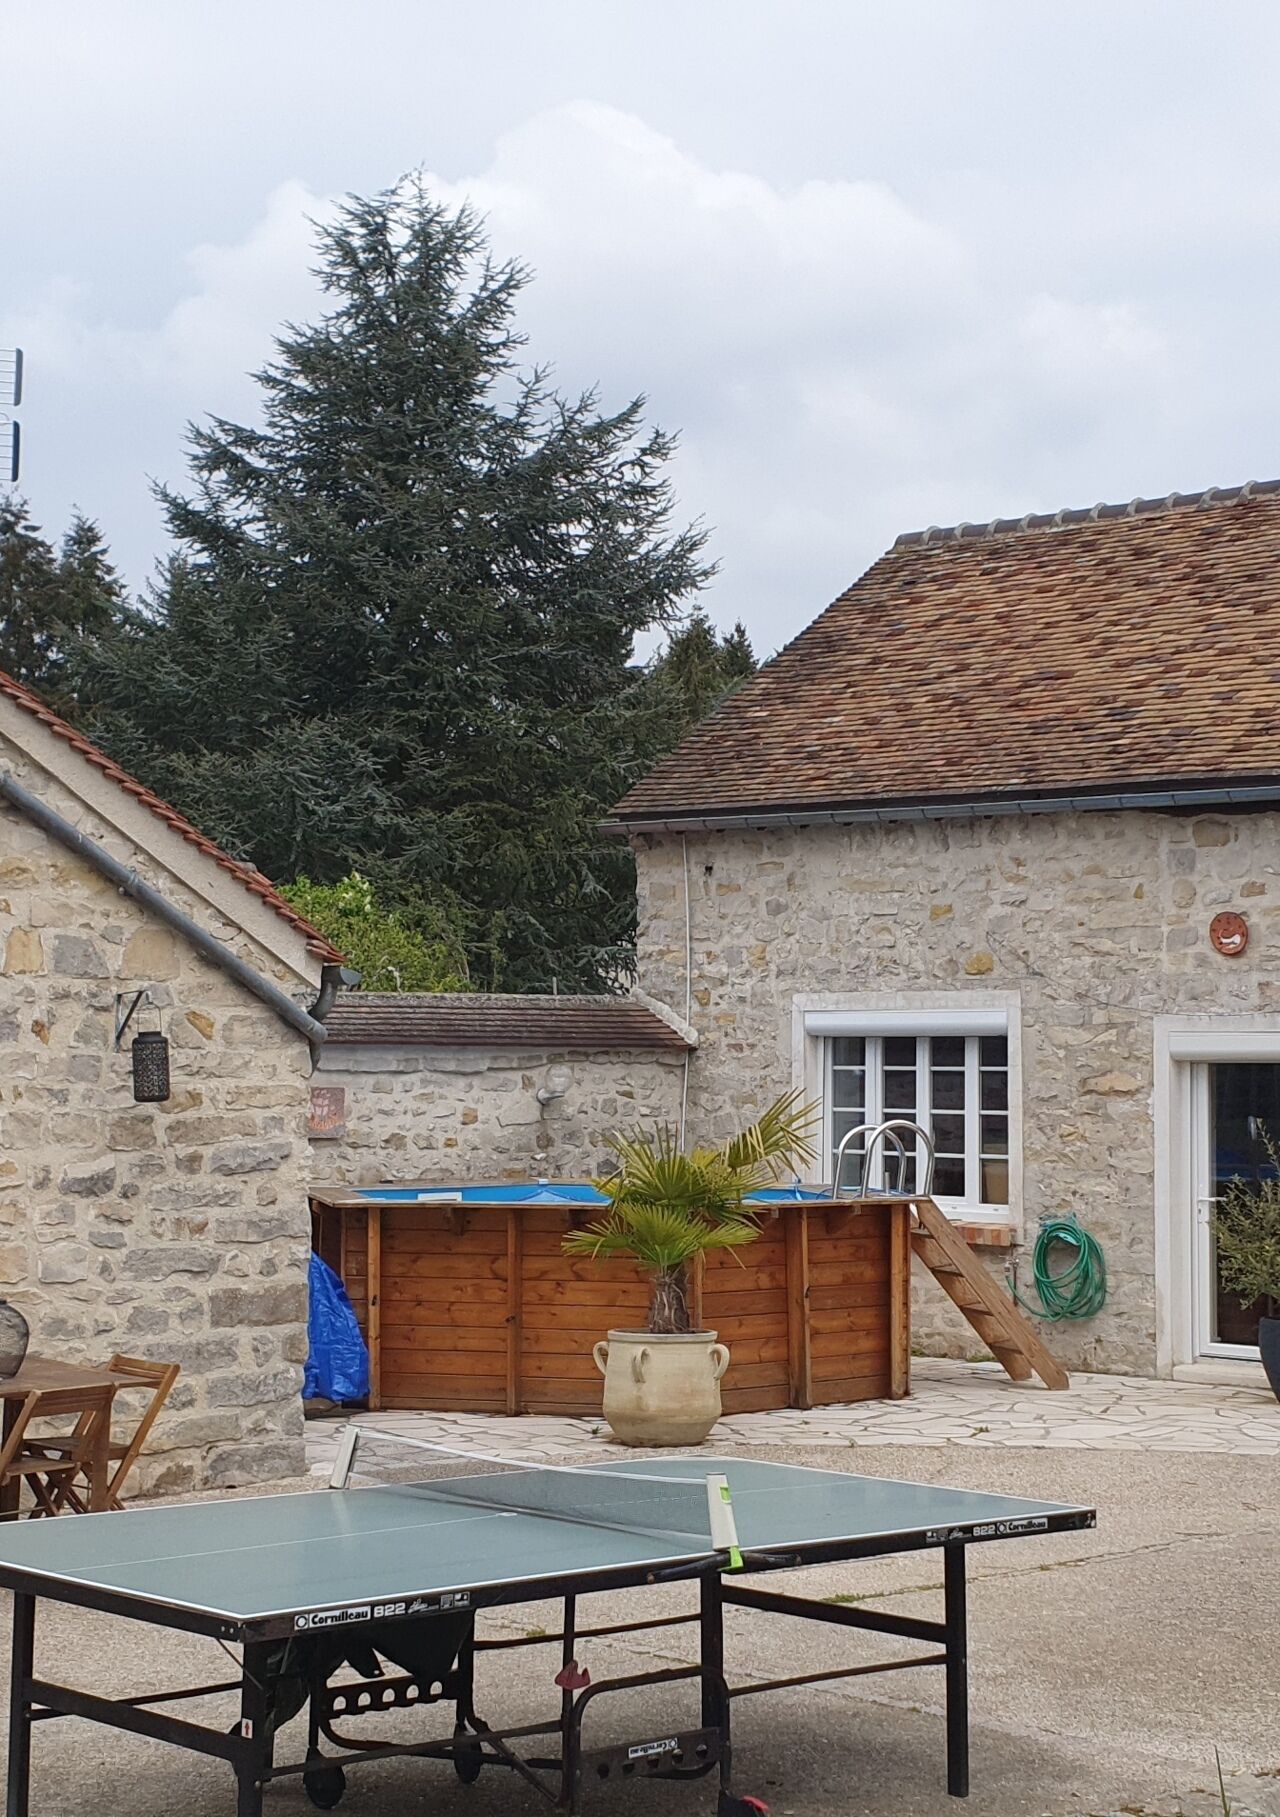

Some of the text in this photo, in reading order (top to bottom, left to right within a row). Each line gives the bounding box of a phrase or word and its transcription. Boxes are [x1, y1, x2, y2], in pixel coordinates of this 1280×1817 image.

[973, 1524, 996, 1536] 822
[1008, 1519, 1046, 1532] Cornilleau
[311, 1609, 369, 1625] Cornilleau
[373, 1603, 406, 1618] 822
